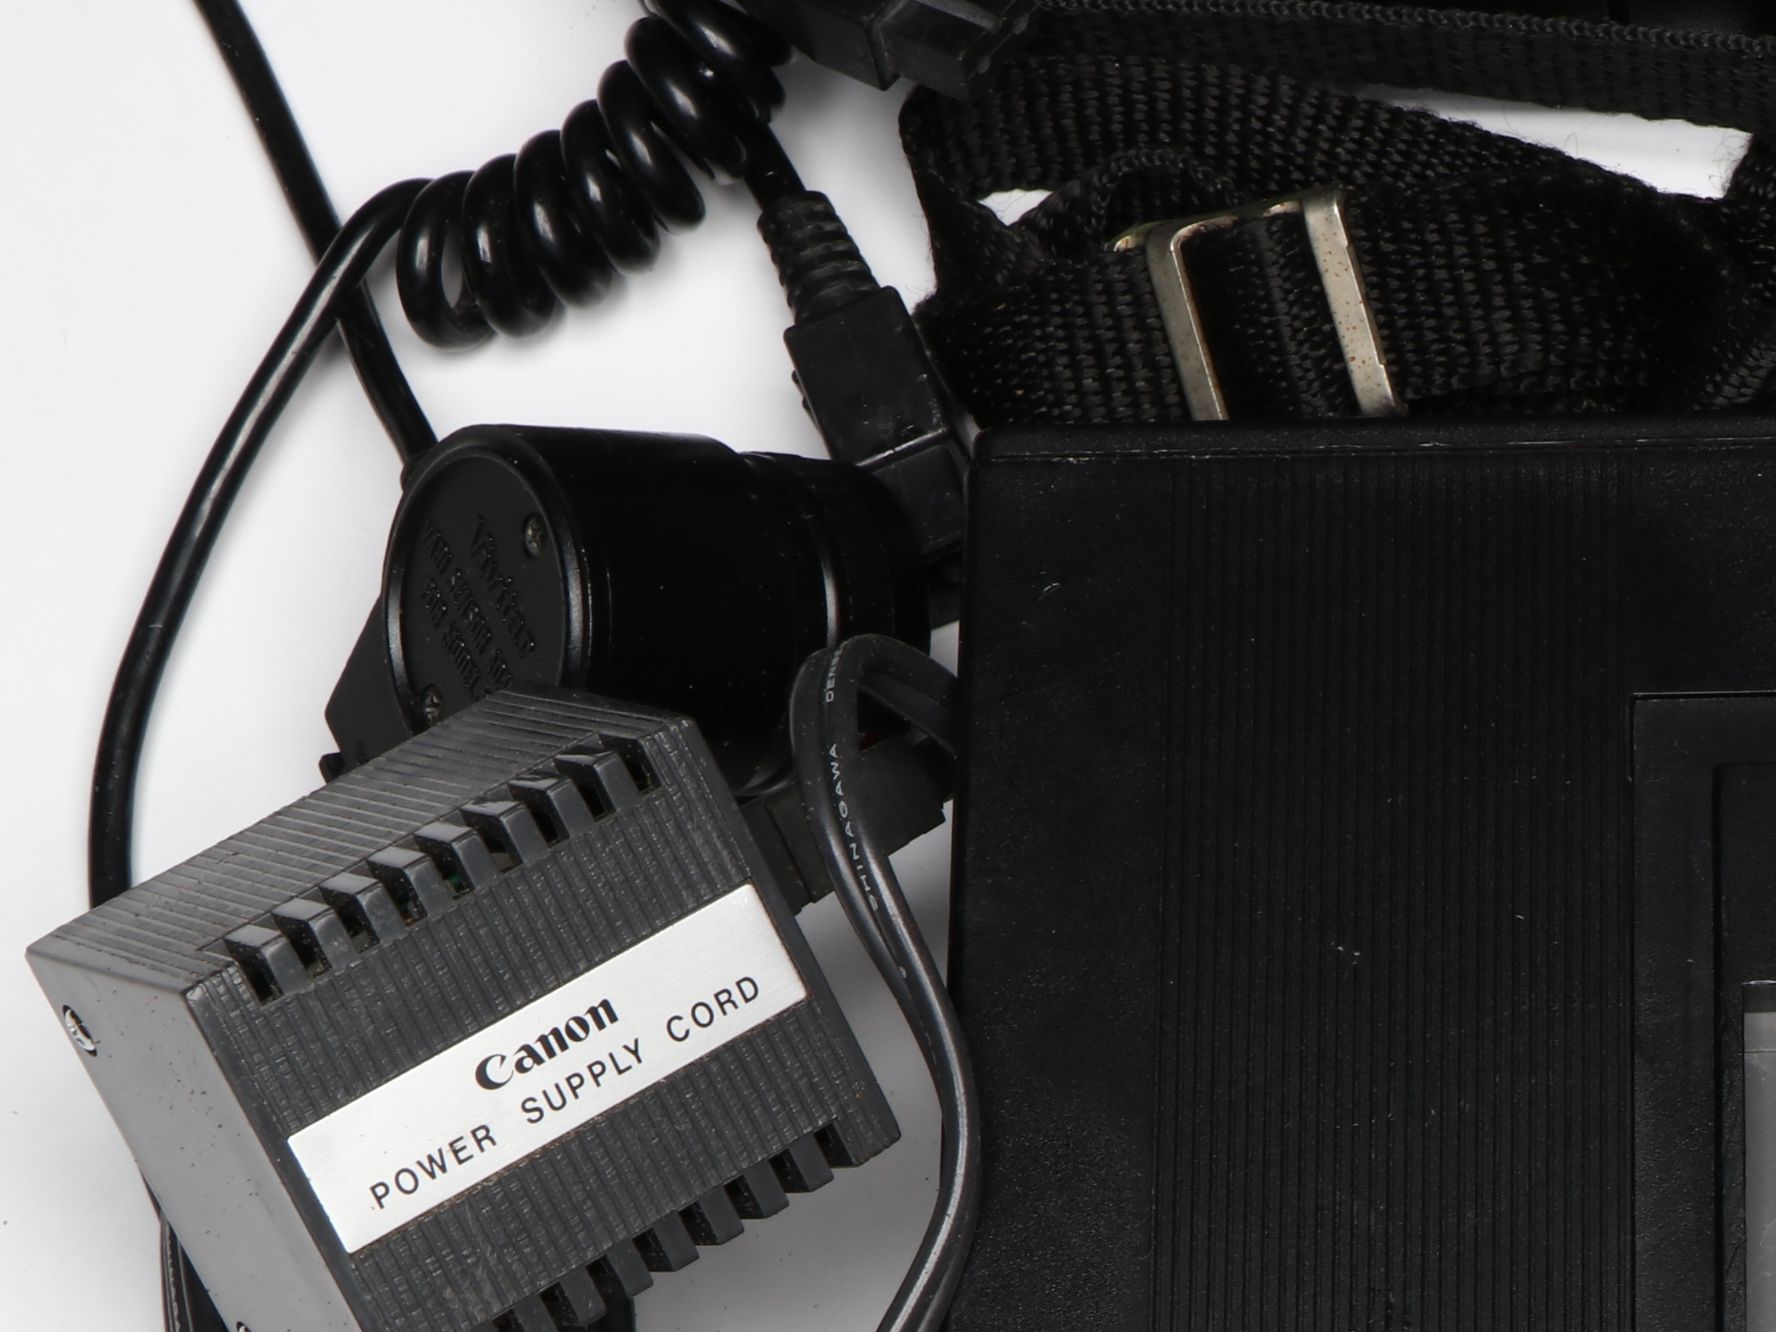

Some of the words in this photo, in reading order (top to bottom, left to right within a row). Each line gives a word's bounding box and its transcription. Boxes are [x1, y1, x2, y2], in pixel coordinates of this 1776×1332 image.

[469, 512, 537, 660] Vivitar
[827, 742, 879, 913] SHINAGAWA
[370, 1124, 498, 1211] POWER
[521, 1038, 646, 1124] SUPPLY
[665, 974, 762, 1045] CORD
[475, 994, 620, 1093] Canon
